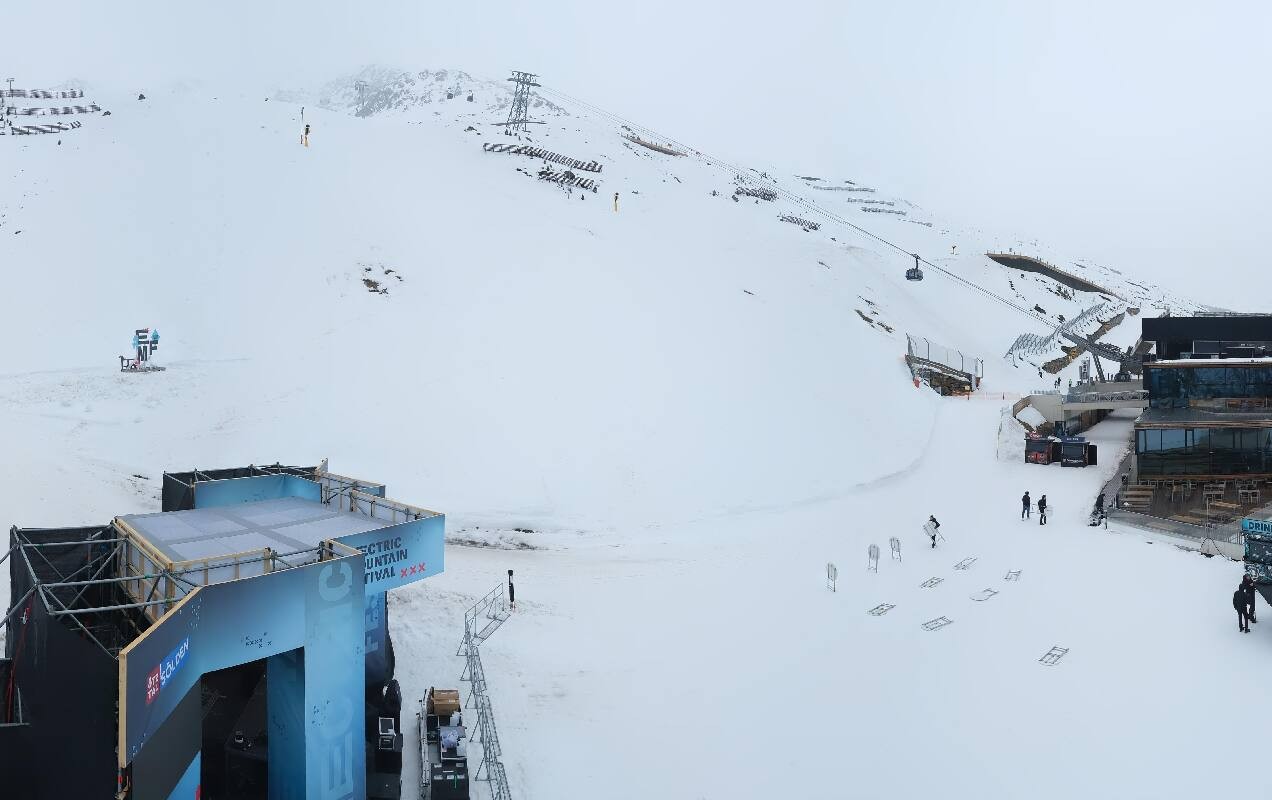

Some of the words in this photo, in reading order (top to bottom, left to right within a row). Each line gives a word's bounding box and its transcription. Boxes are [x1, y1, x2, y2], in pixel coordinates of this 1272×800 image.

[357, 537, 402, 556] ECTRIC
[365, 549, 408, 569] UNTAIN
[364, 566, 395, 584] TIVAL
[160, 637, 189, 686] SÖLDEN
